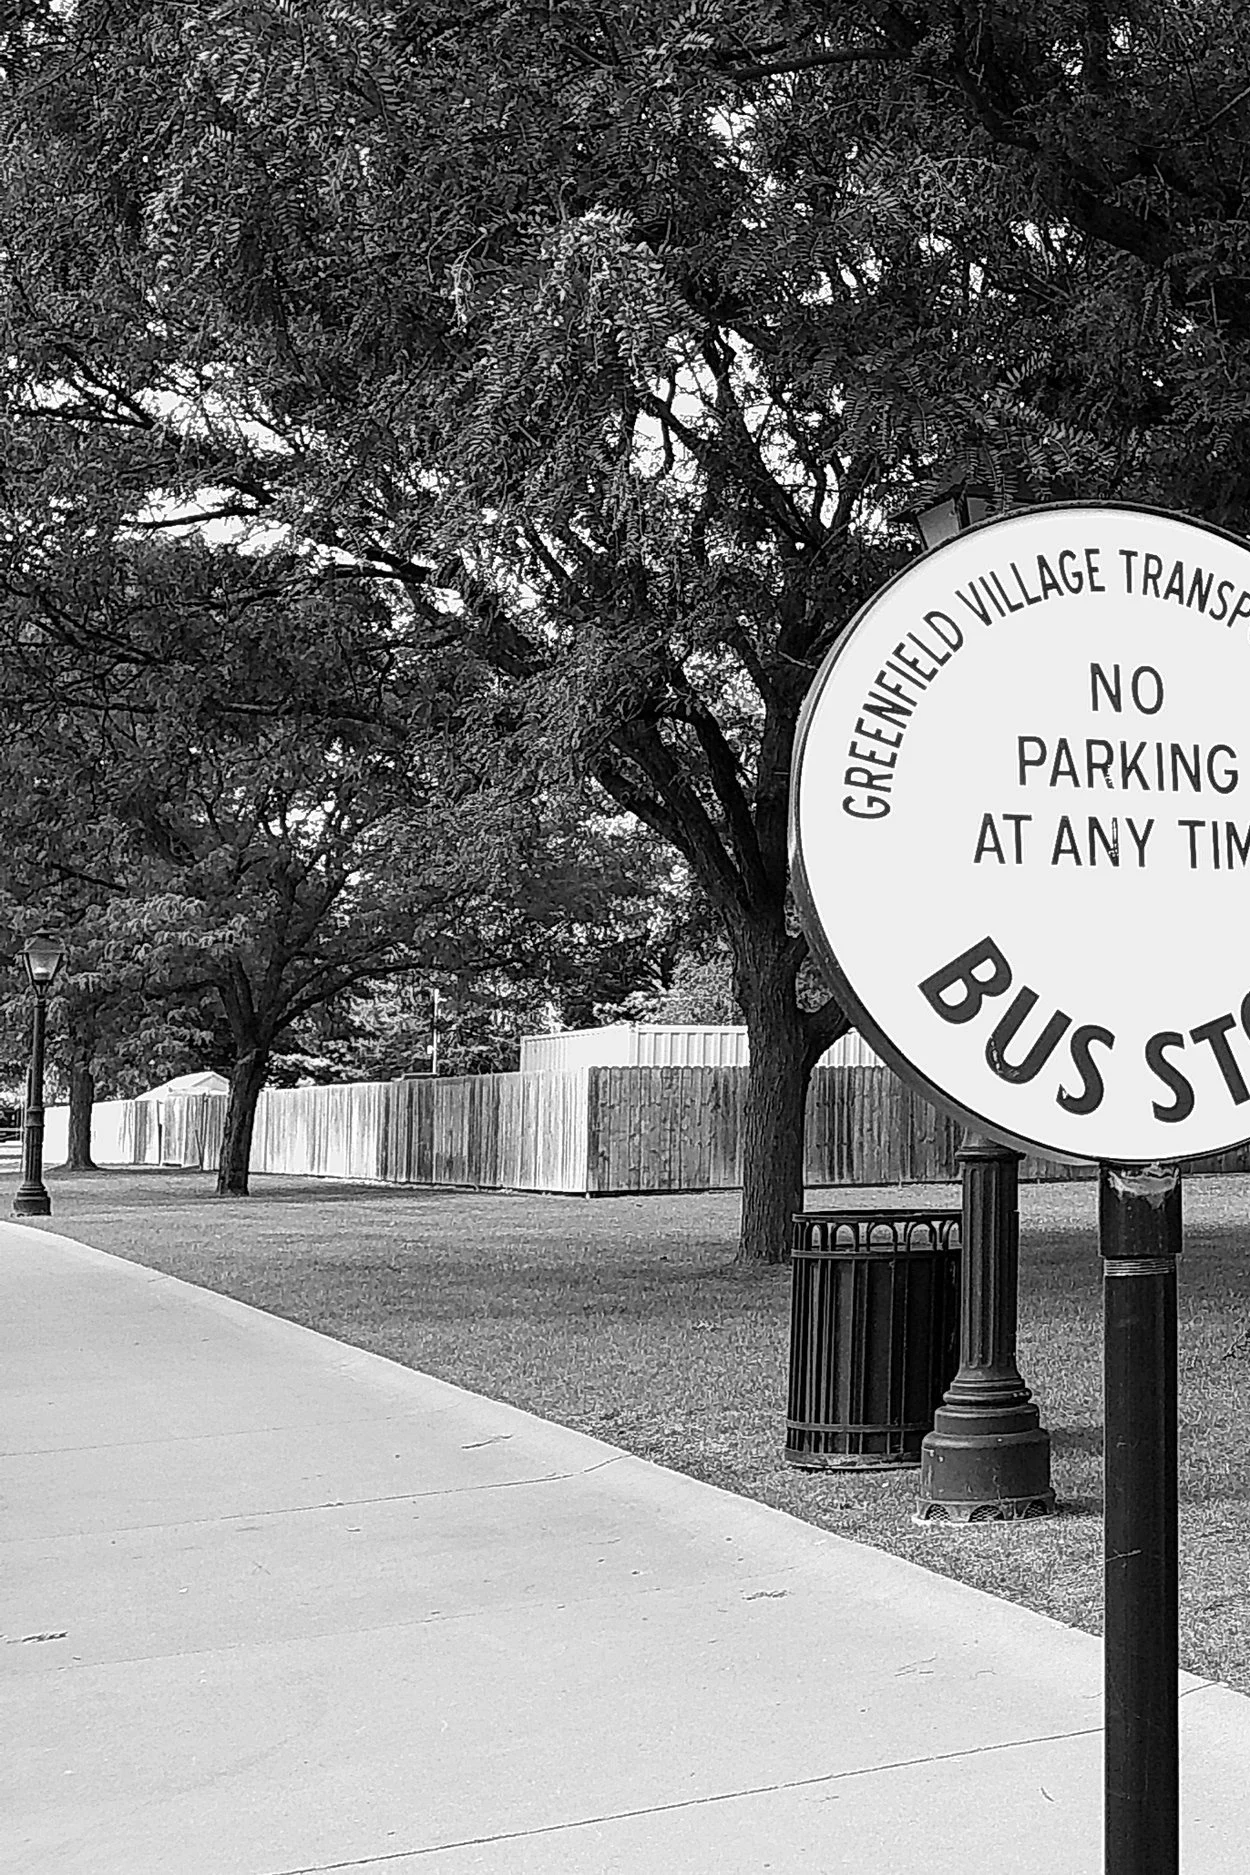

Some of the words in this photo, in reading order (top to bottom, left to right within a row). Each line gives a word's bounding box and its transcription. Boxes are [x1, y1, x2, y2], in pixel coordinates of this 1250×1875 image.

[841, 609, 964, 820] GREENFIELD
[954, 547, 1106, 627] VILLAGE
[1089, 661, 1164, 715] NO
[1016, 734, 1239, 795] PARKING
[972, 811, 1033, 866] AT
[1050, 814, 1156, 868] ANY
[916, 934, 1116, 1117] BUS
